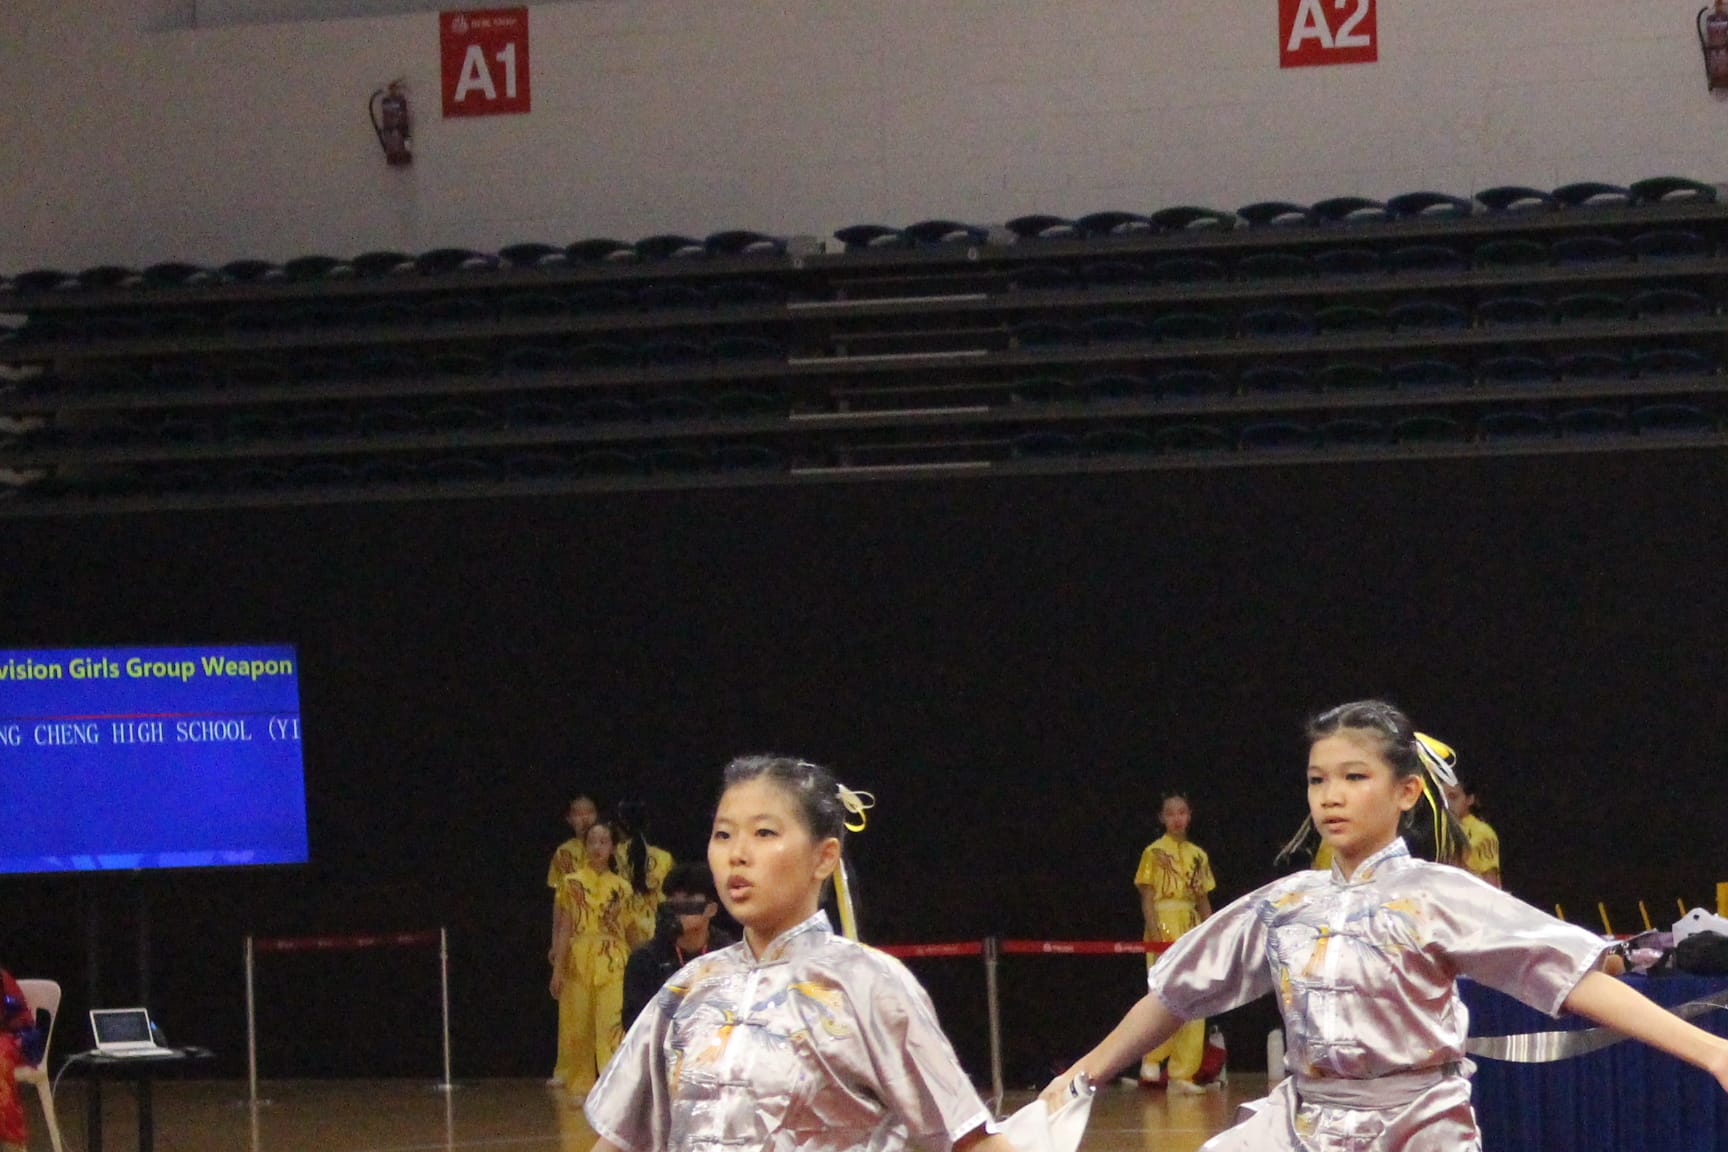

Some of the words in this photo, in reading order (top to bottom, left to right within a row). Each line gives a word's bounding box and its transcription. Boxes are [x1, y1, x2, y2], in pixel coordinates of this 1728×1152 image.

[1287, 0, 1370, 52] A2
[454, 43, 517, 101] A1
[69, 657, 120, 679] Girls
[126, 657, 195, 682] Group
[201, 656, 293, 681] Weapon
[34, 723, 99, 745] CHENG
[112, 721, 163, 743] HIGH
[176, 720, 252, 742] SCHOOL
